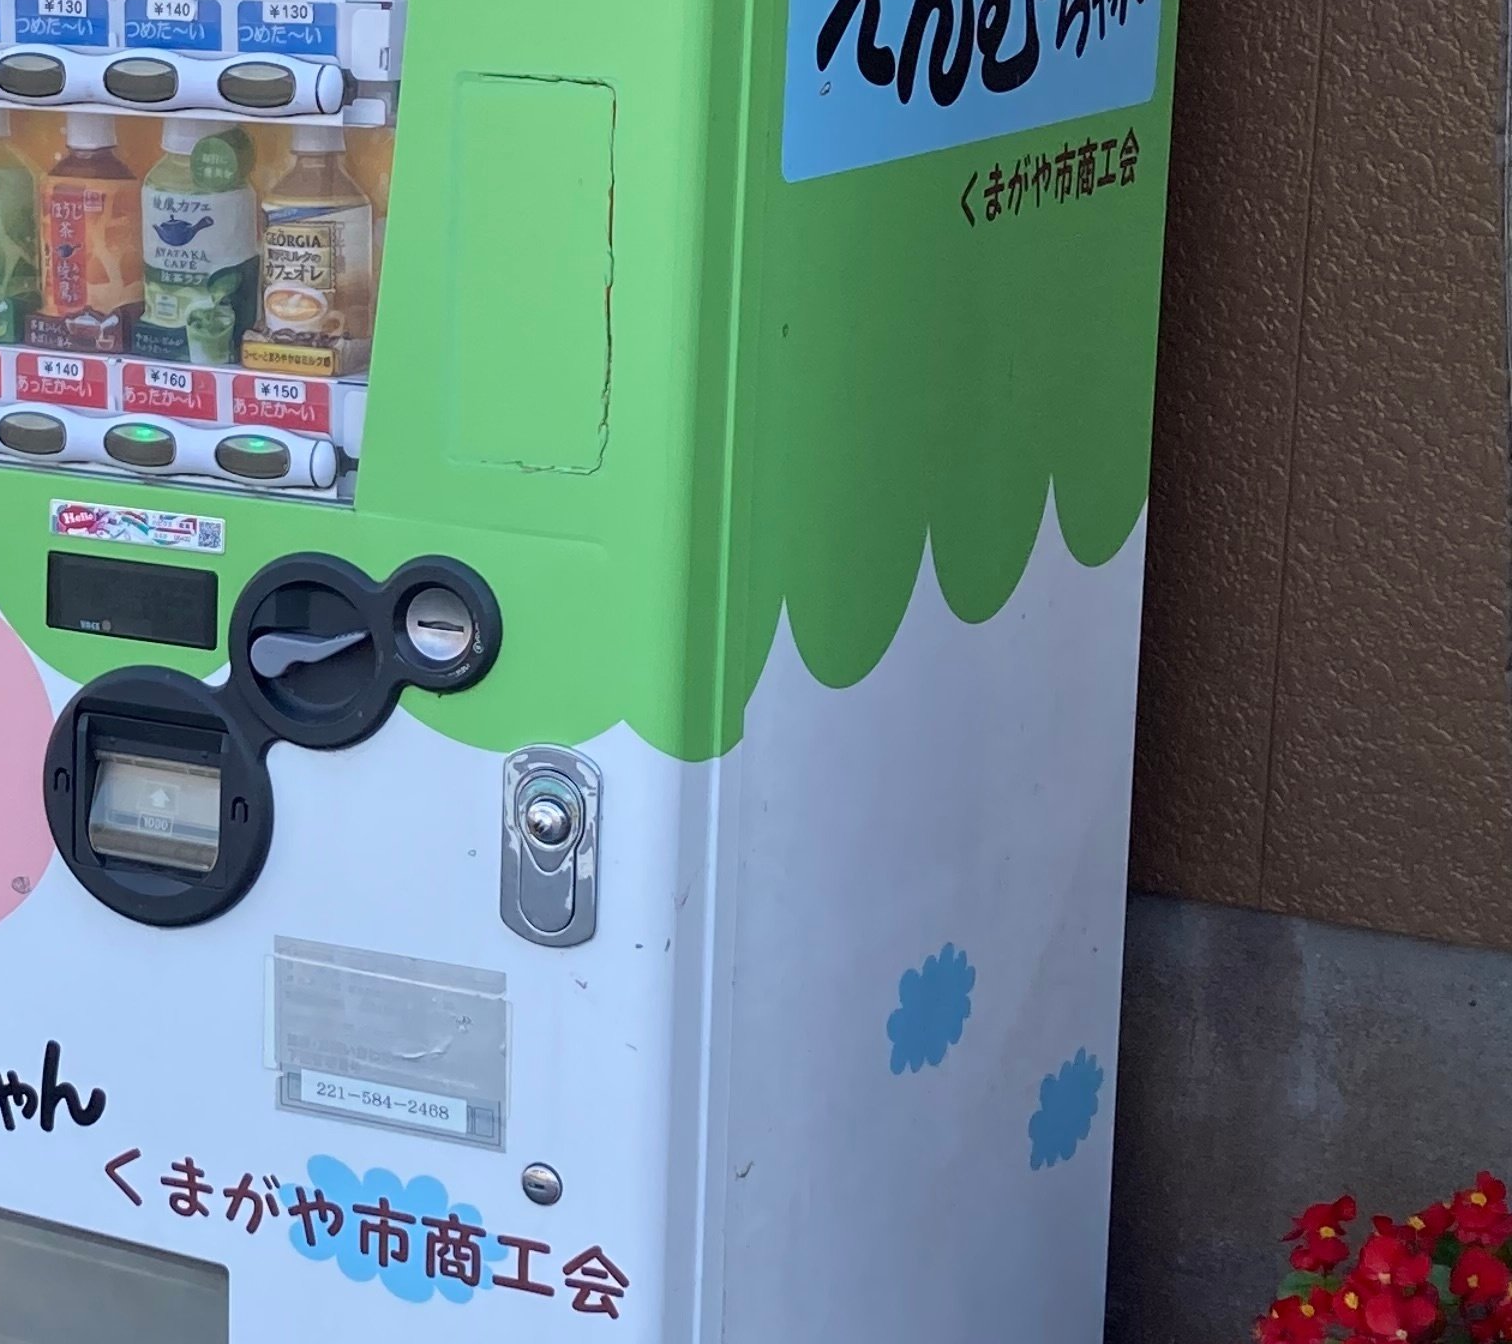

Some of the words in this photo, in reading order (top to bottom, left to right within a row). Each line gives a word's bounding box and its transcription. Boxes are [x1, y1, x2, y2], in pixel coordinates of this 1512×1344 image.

[44, 0, 84, 15] ¥130
[153, 2, 192, 17] ¥140
[269, 4, 309, 20] ¥130
[960, 127, 1140, 228] くまがや市商工会
[155, 246, 211, 263] AYATAKA
[265, 261, 325, 282] カフェオレ
[44, 360, 79, 377] ¥140
[150, 369, 186, 389] ¥160
[261, 382, 299, 400] ¥150
[315, 1080, 451, 1123] 221-584-2468
[104, 1147, 630, 1321] くまがや市商工会
